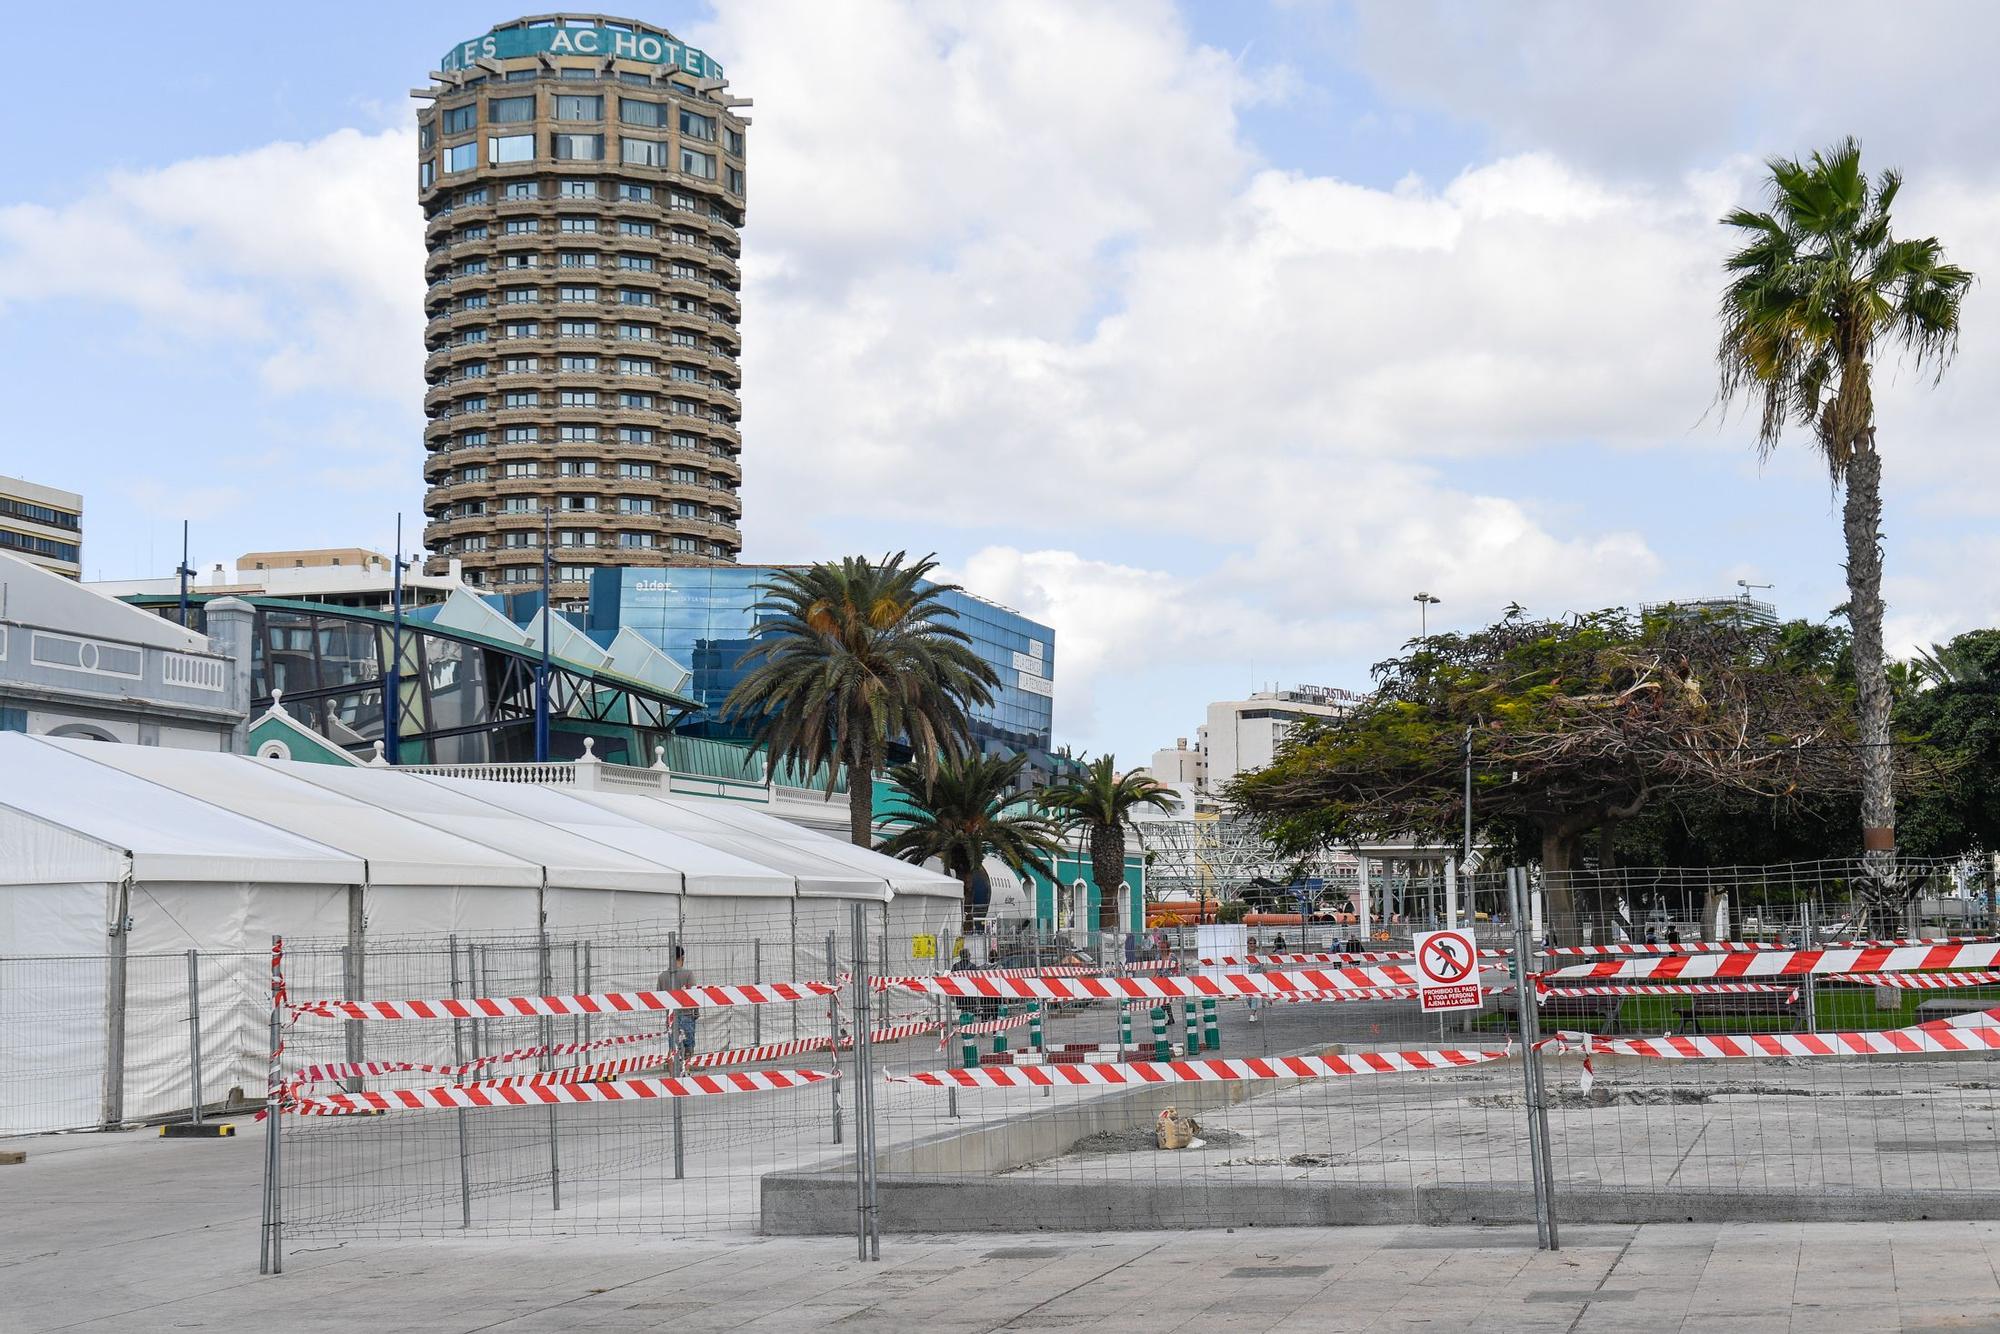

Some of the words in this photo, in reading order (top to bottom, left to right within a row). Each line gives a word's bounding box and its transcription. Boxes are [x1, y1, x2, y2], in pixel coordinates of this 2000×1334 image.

[550, 29, 599, 53] AC
[1299, 684, 1320, 695] HOTEL
[1322, 687, 1352, 700] CRISTINA
